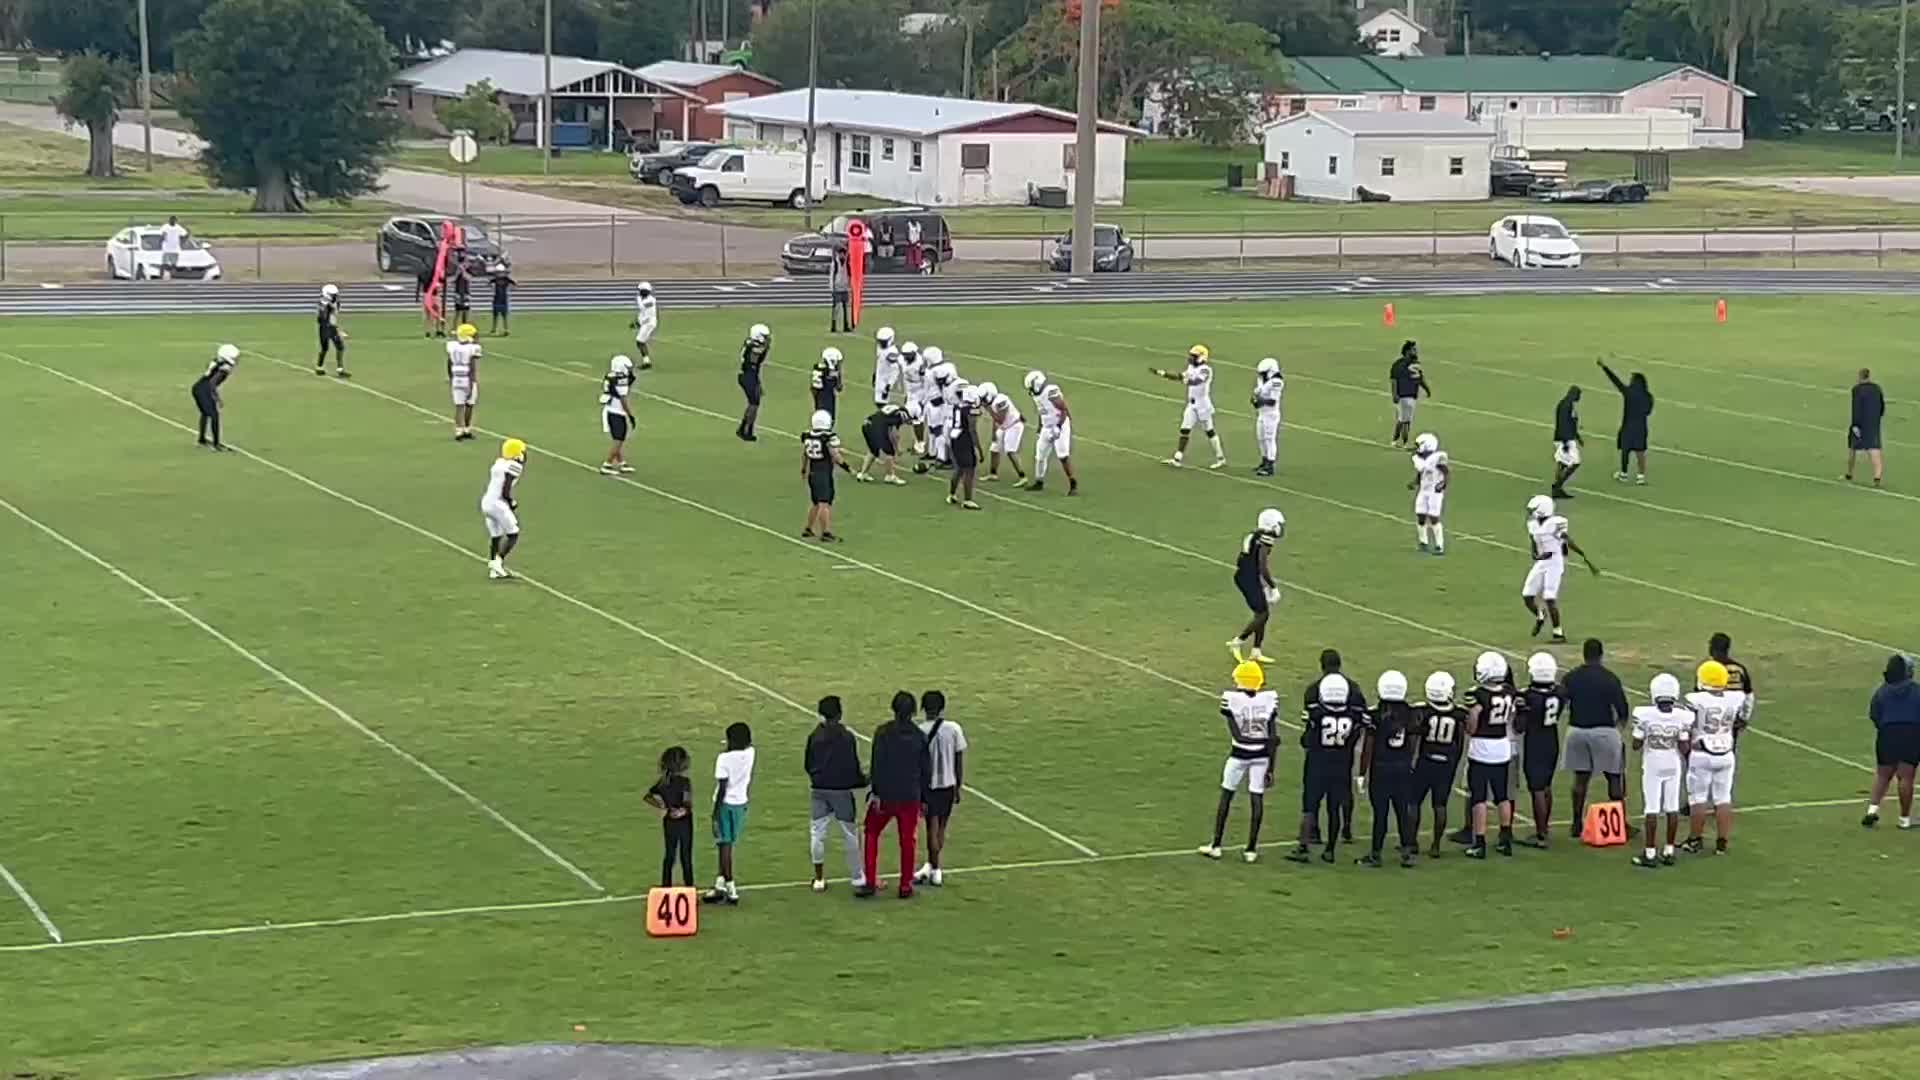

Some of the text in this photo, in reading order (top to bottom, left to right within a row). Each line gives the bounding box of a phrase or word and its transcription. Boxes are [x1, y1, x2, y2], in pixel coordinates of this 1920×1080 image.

[804, 439, 824, 459] 22
[1489, 695, 1512, 724] 21
[1543, 696, 1559, 726] 2
[1321, 716, 1352, 746] 28
[1426, 715, 1456, 743] 10
[1599, 807, 1621, 838] 30
[657, 893, 690, 928] 40
